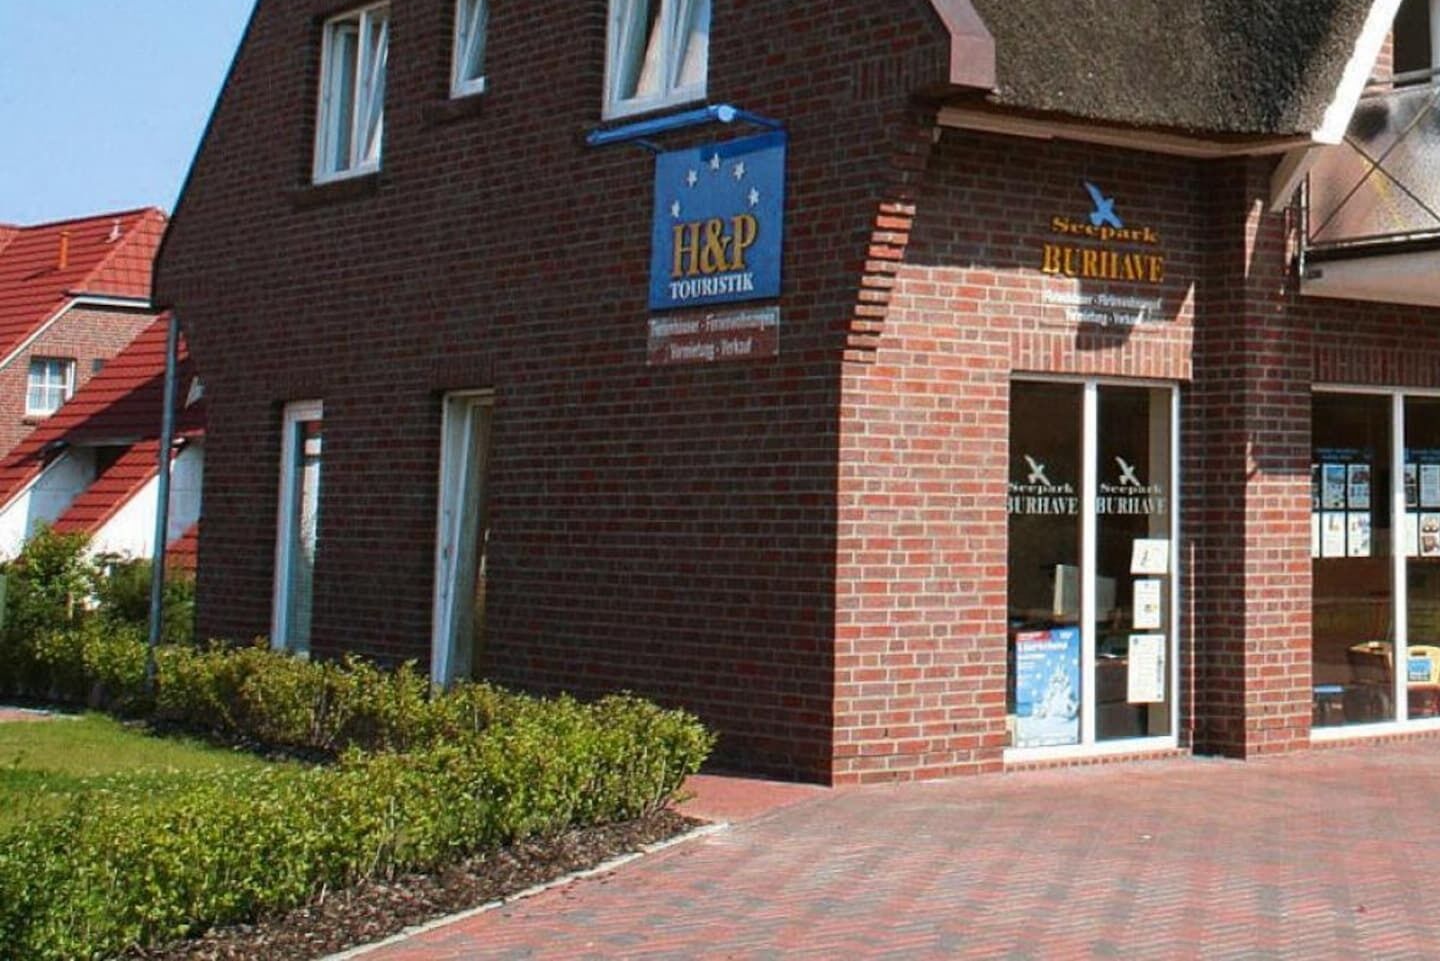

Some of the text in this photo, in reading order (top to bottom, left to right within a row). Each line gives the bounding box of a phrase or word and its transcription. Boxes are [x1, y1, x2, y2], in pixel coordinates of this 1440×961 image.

[1052, 216, 1160, 242] Seepark
[672, 214, 758, 278] H&P
[1042, 244, 1164, 283] BURHAVE
[669, 273, 754, 300] TOURISTIK
[1095, 496, 1166, 514] BURHAVE
